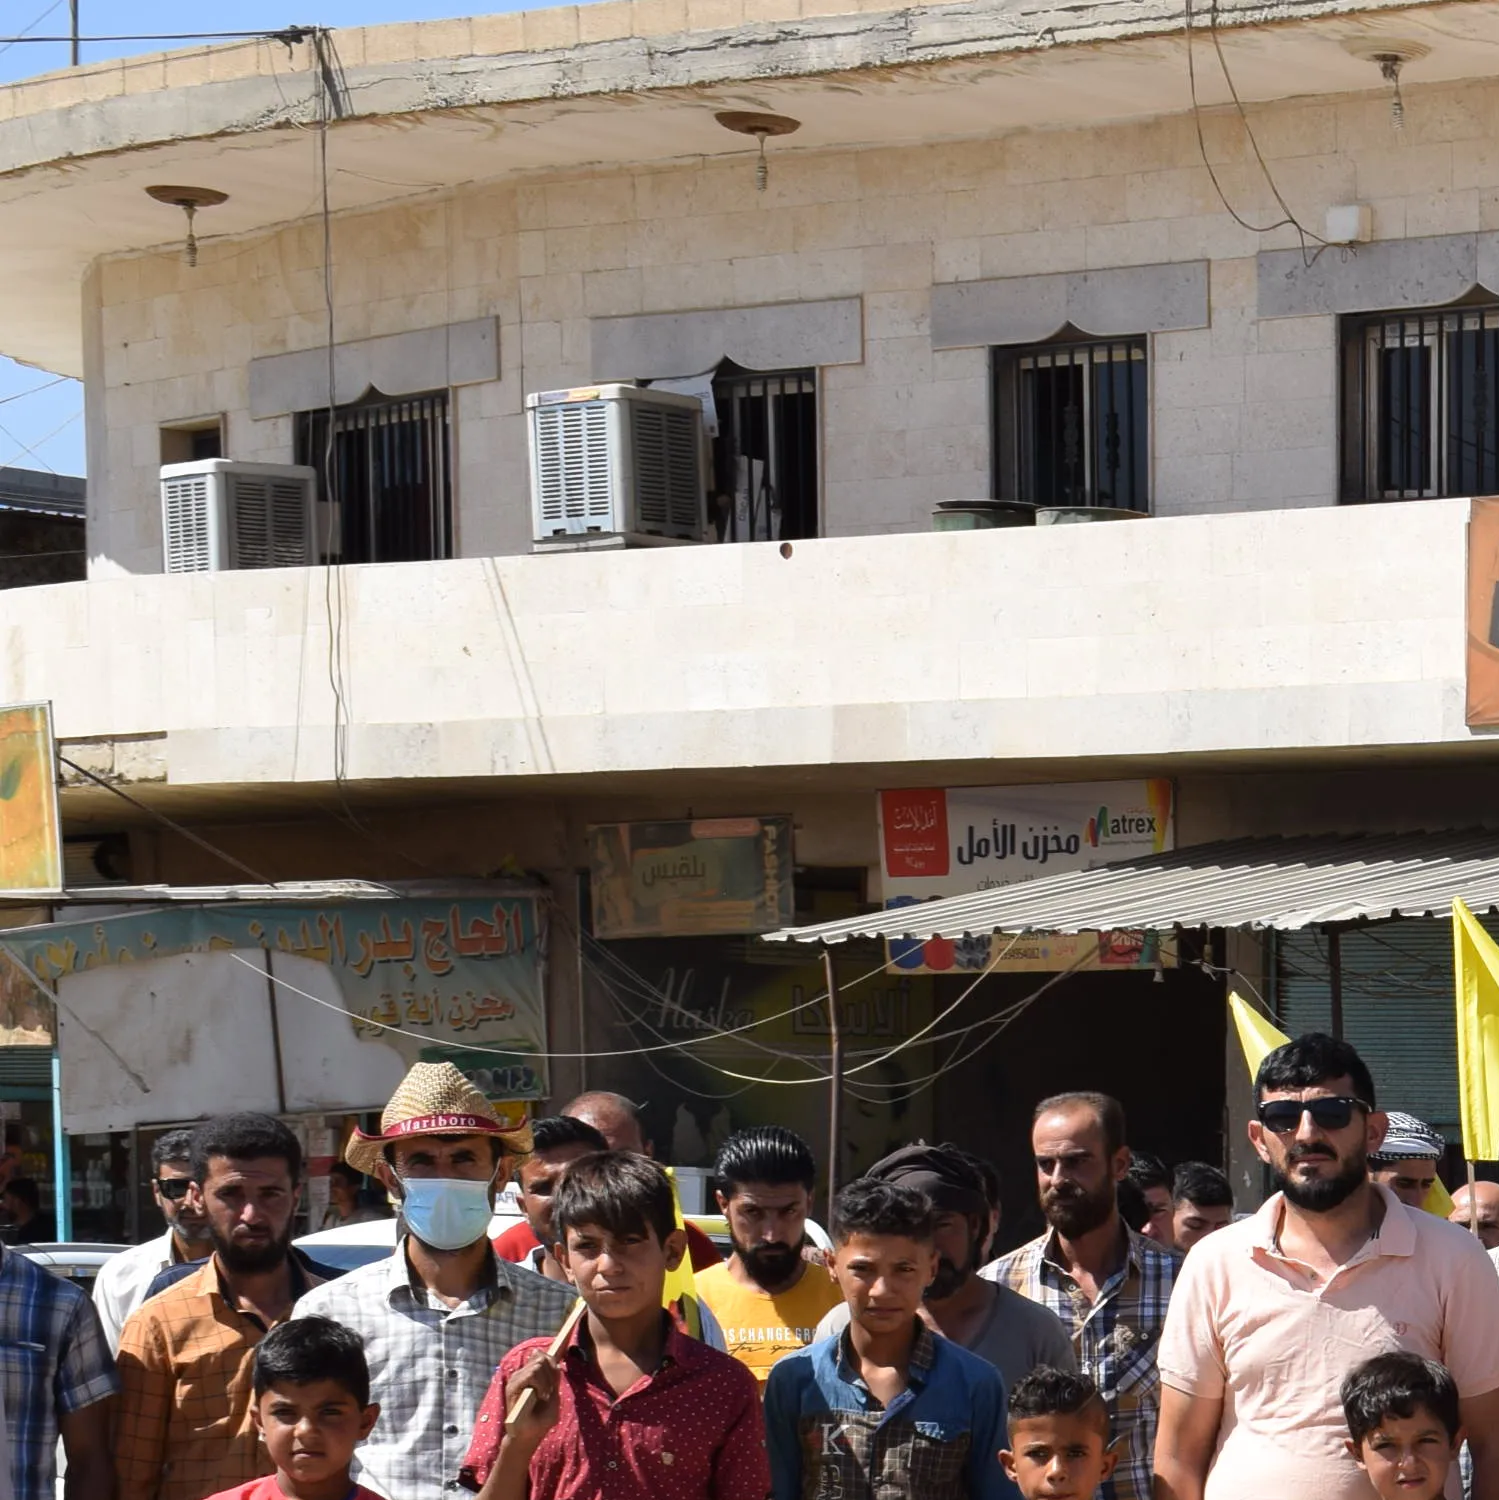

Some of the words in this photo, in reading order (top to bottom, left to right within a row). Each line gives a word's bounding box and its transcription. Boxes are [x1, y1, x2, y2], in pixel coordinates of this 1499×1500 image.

[956, 817, 1017, 866] الأمل
[1021, 825, 1081, 866] مخزن
[1084, 806, 1157, 848] Matrex
[641, 854, 707, 888] بلقيس
[348, 912, 415, 982] بدر
[420, 902, 525, 976] الحاج
[448, 989, 516, 1032] مخزن
[613, 966, 754, 1033] Alaska
[792, 975, 914, 1037] ألاسكا
[739, 1327, 792, 1343] CHANGE
[819, 1422, 847, 1457] K
